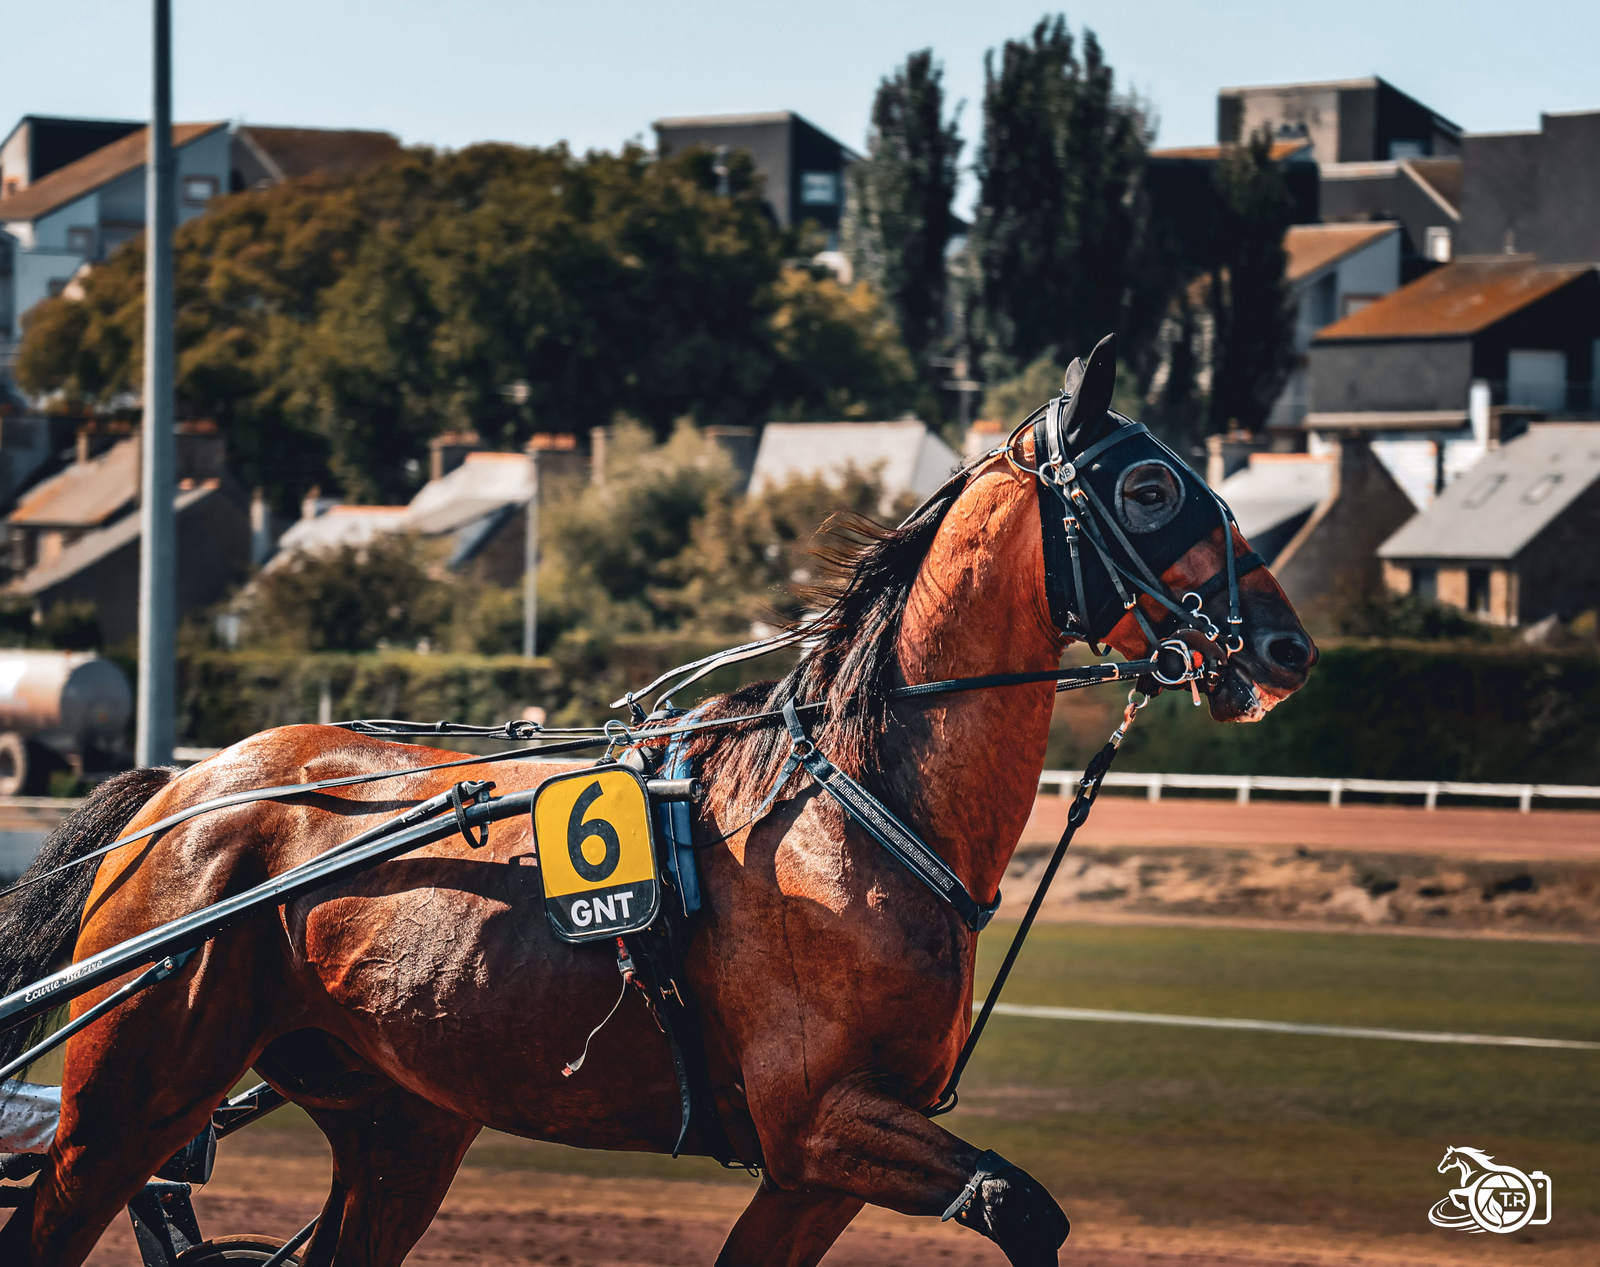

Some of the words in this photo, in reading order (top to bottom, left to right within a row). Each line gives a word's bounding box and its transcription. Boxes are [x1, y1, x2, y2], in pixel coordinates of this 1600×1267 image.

[567, 780, 620, 882] 6
[571, 891, 634, 927] GNT
[25, 980, 60, 1002] Ecurie
